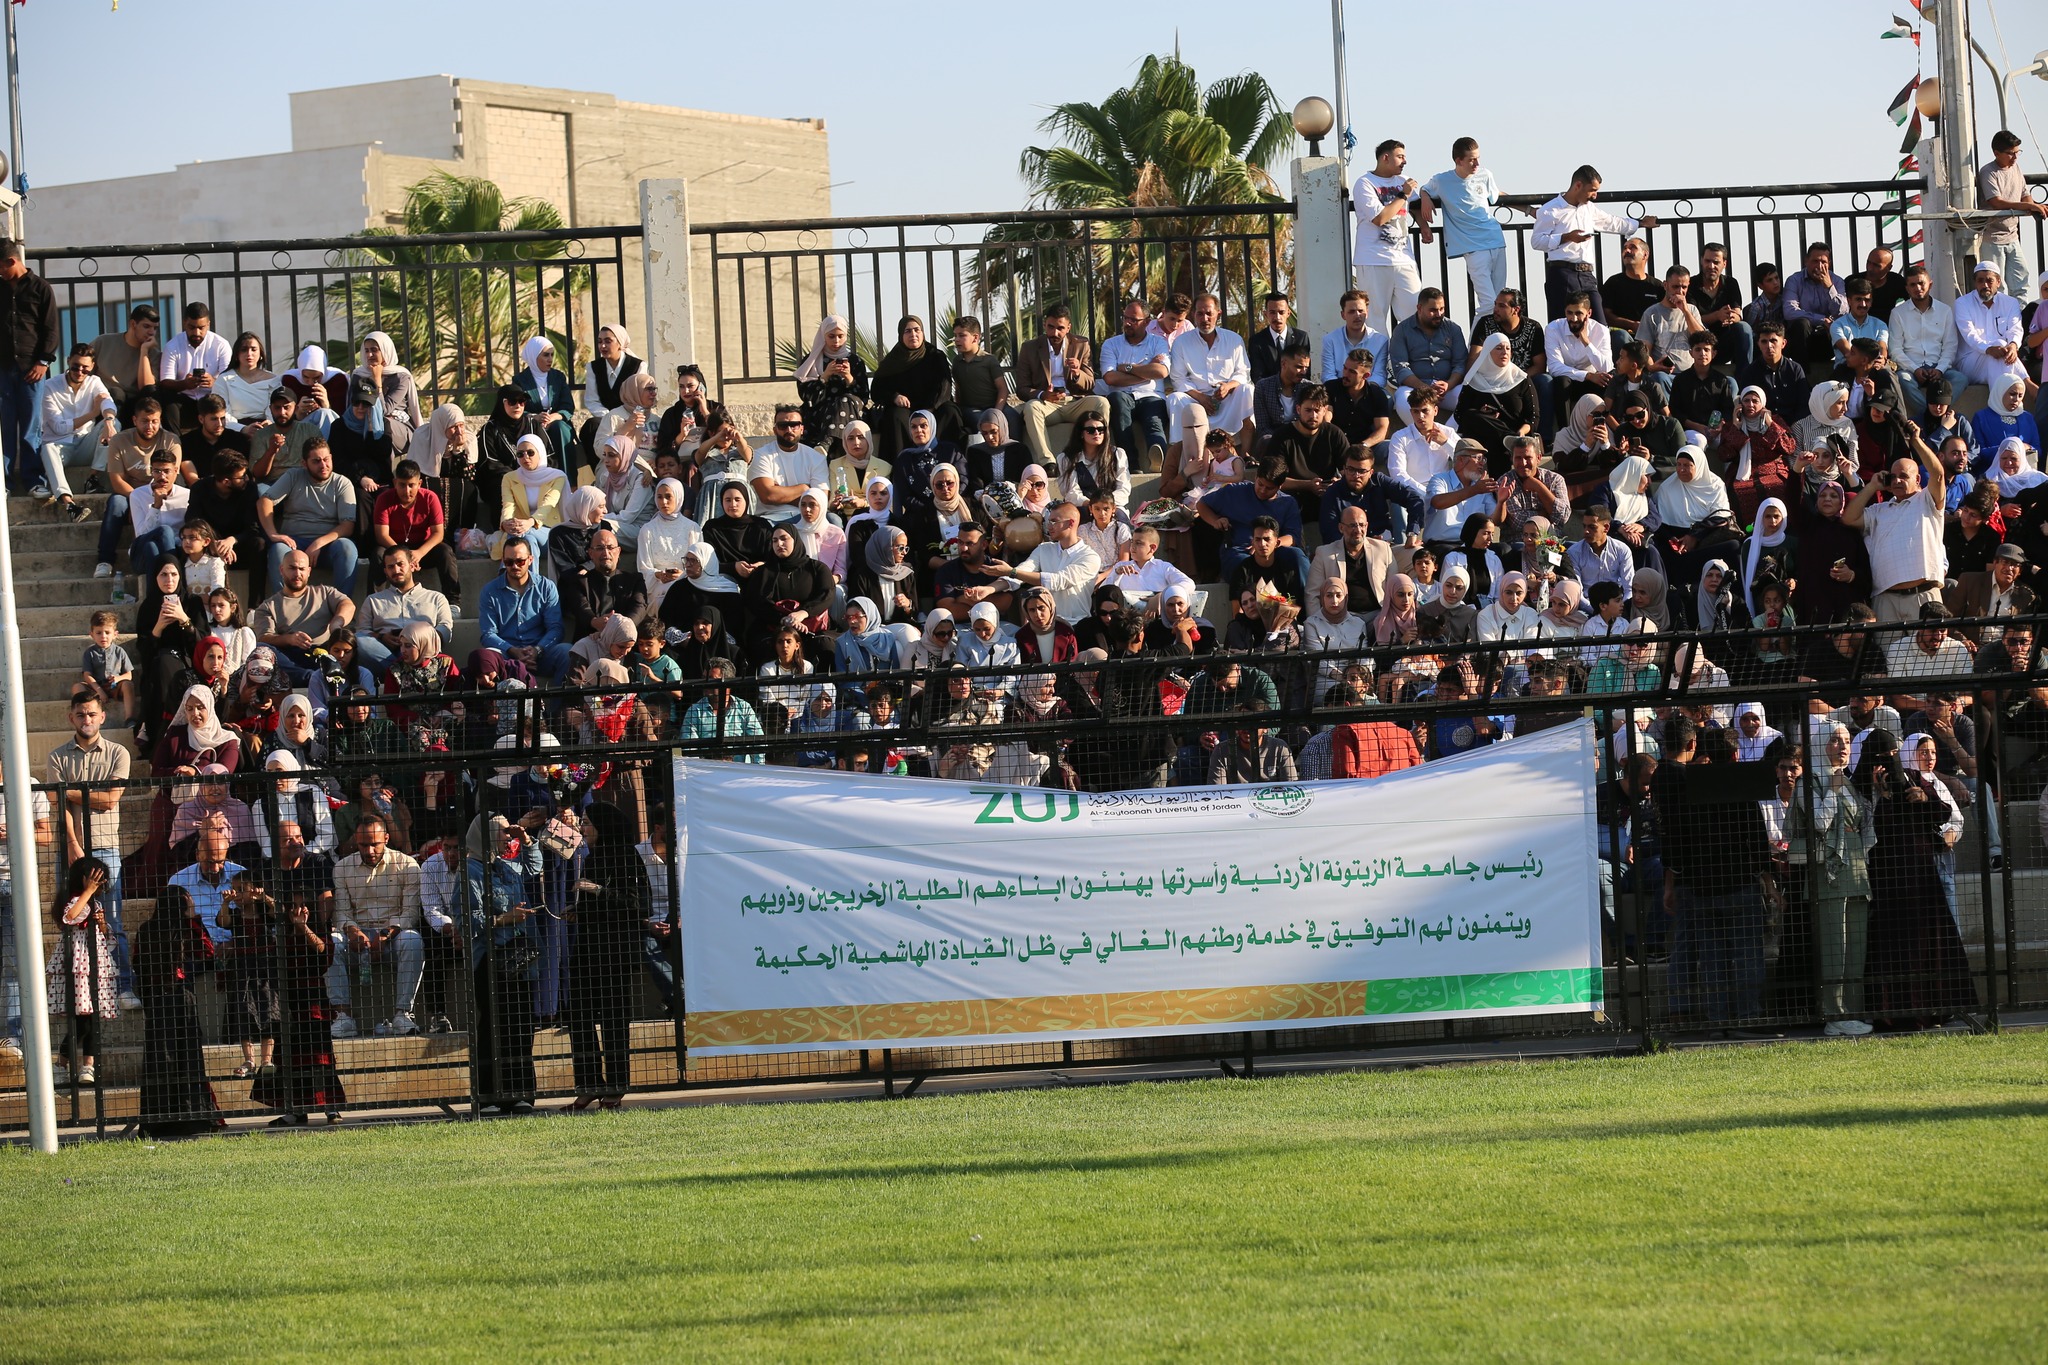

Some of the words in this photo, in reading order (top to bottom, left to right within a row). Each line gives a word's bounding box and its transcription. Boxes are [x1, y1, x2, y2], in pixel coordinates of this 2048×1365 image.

[969, 790, 1079, 824] ZUJ
[1090, 808, 1151, 817] Al-Zaytoonah
[1154, 805, 1198, 814] University
[1212, 803, 1242, 811] Jordan
[1162, 862, 1227, 895] وأسرتها
[1229, 854, 1319, 892] الأردنية
[1322, 859, 1391, 888] الزيتونة
[1394, 857, 1480, 881] جامعة
[1484, 851, 1543, 880] رئيس
[808, 881, 893, 913] الخريجين
[896, 878, 969, 910] الطلبة
[973, 875, 1066, 906] ابناءهم
[1071, 870, 1153, 900] يهنئون
[741, 885, 804, 916] وذويهم
[1181, 927, 1243, 956] وطنهم
[1245, 923, 1302, 945] خدمة
[1305, 920, 1325, 949] في
[1328, 917, 1415, 948] التوفيق
[1419, 915, 1453, 944] لهم
[1458, 912, 1531, 941] ويتمنون
[755, 944, 843, 974] الحكيمة
[846, 940, 935, 971] الهاشمية
[939, 937, 1013, 966] القيادة
[1018, 935, 1055, 962] ظل
[1060, 932, 1092, 965] في
[1096, 928, 1176, 963] الغالي
